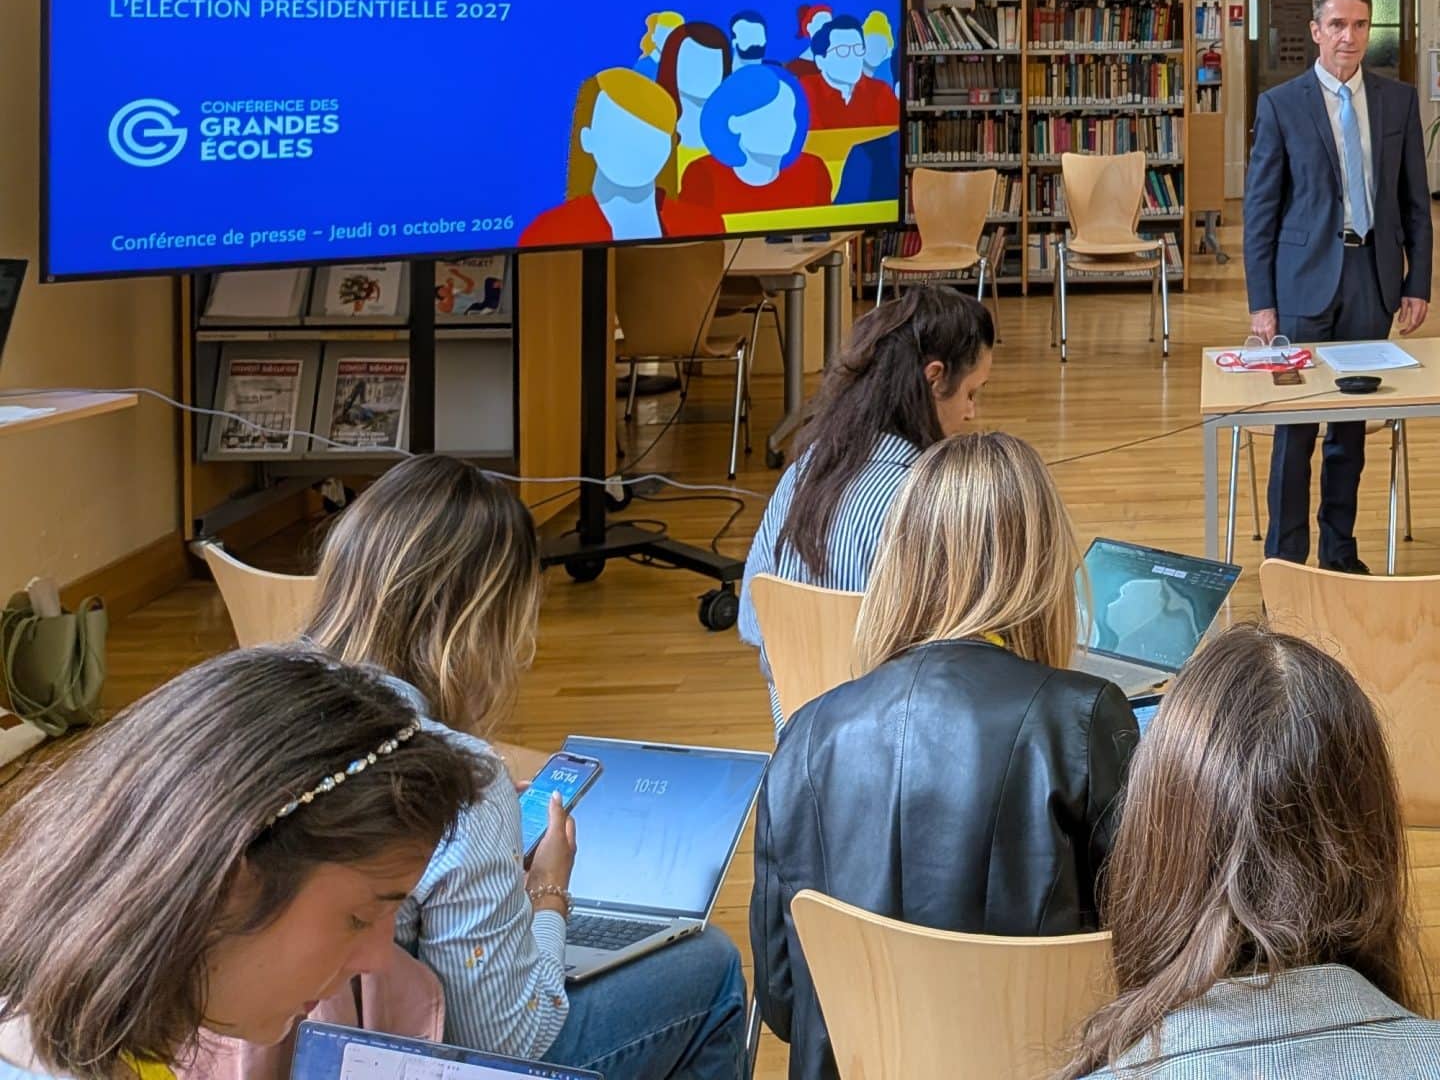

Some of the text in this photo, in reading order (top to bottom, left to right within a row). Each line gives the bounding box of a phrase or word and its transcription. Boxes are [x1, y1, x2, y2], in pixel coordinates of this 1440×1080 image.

[456, 2, 511, 21] 2027
[310, 98, 339, 112] DES
[200, 114, 340, 137] GRANDES
[200, 137, 314, 161] ÉCOLES
[111, 232, 217, 251] Conférence
[222, 229, 244, 245] de
[250, 229, 306, 248] presse
[329, 222, 372, 241] Jeudi
[378, 223, 396, 237] 01
[403, 218, 466, 235] octobre
[471, 215, 514, 232] 2026
[550, 769, 578, 784] 10:14
[633, 777, 669, 795] 10:13
